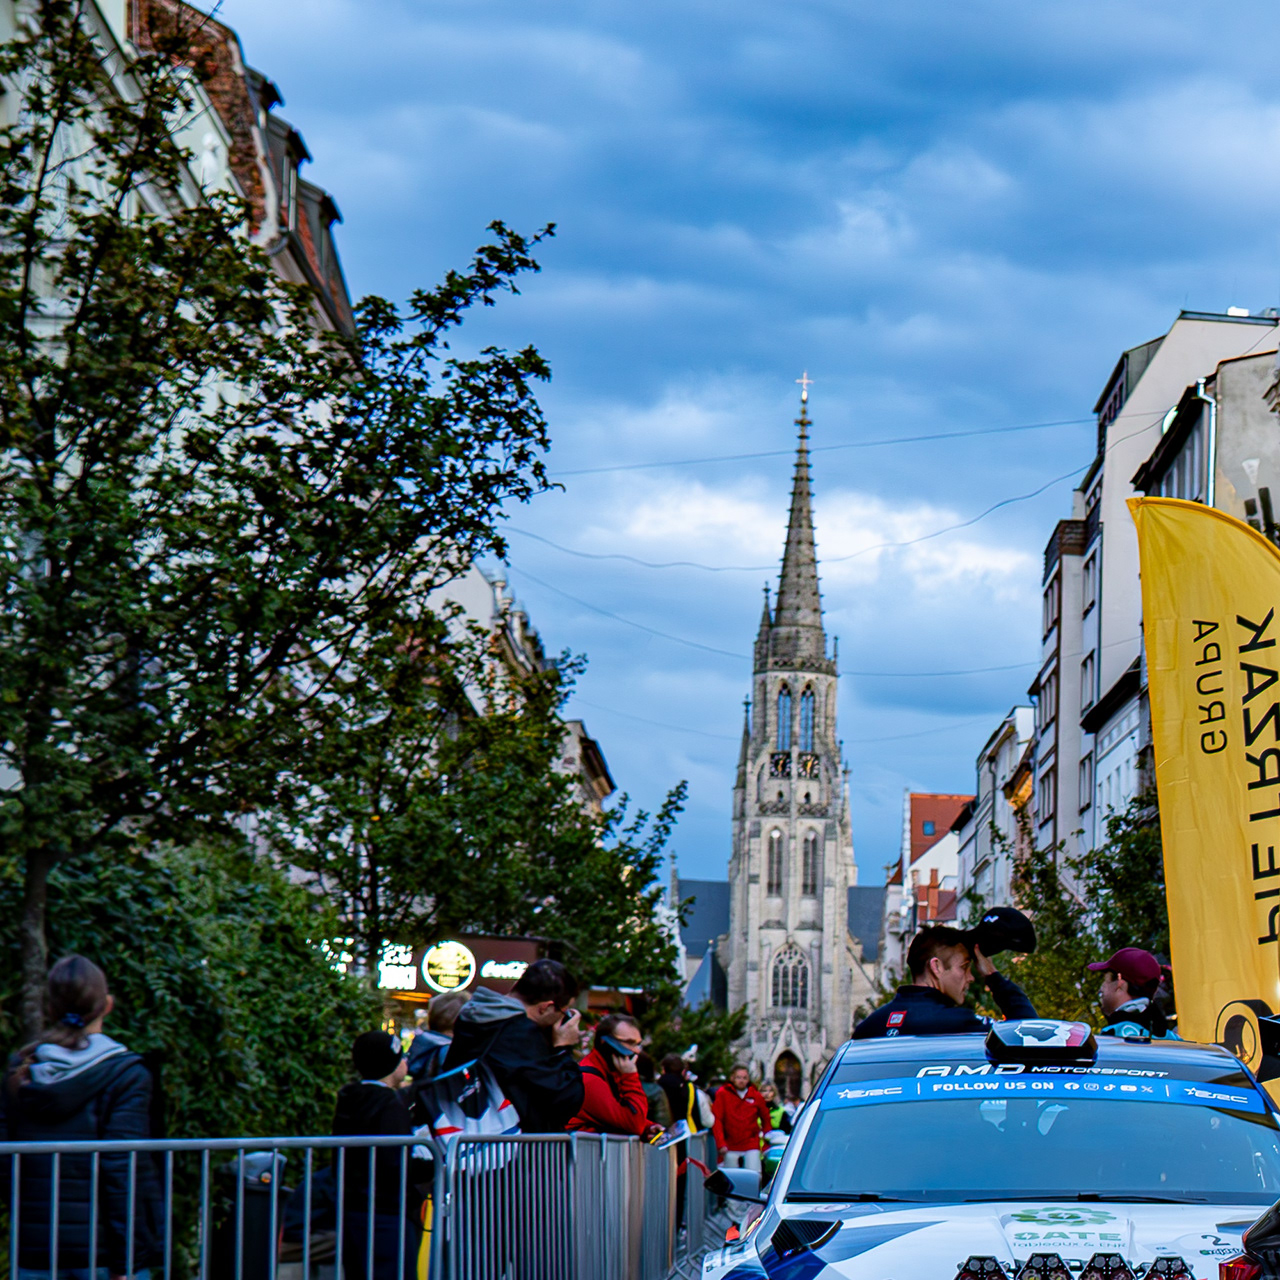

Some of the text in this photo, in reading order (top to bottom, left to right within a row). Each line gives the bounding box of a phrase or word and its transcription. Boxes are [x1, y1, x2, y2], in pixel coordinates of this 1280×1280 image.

[916, 1063, 1170, 1079] AMD MOTORSPORT
[932, 1081, 1055, 1092] FOLLOW US ON
